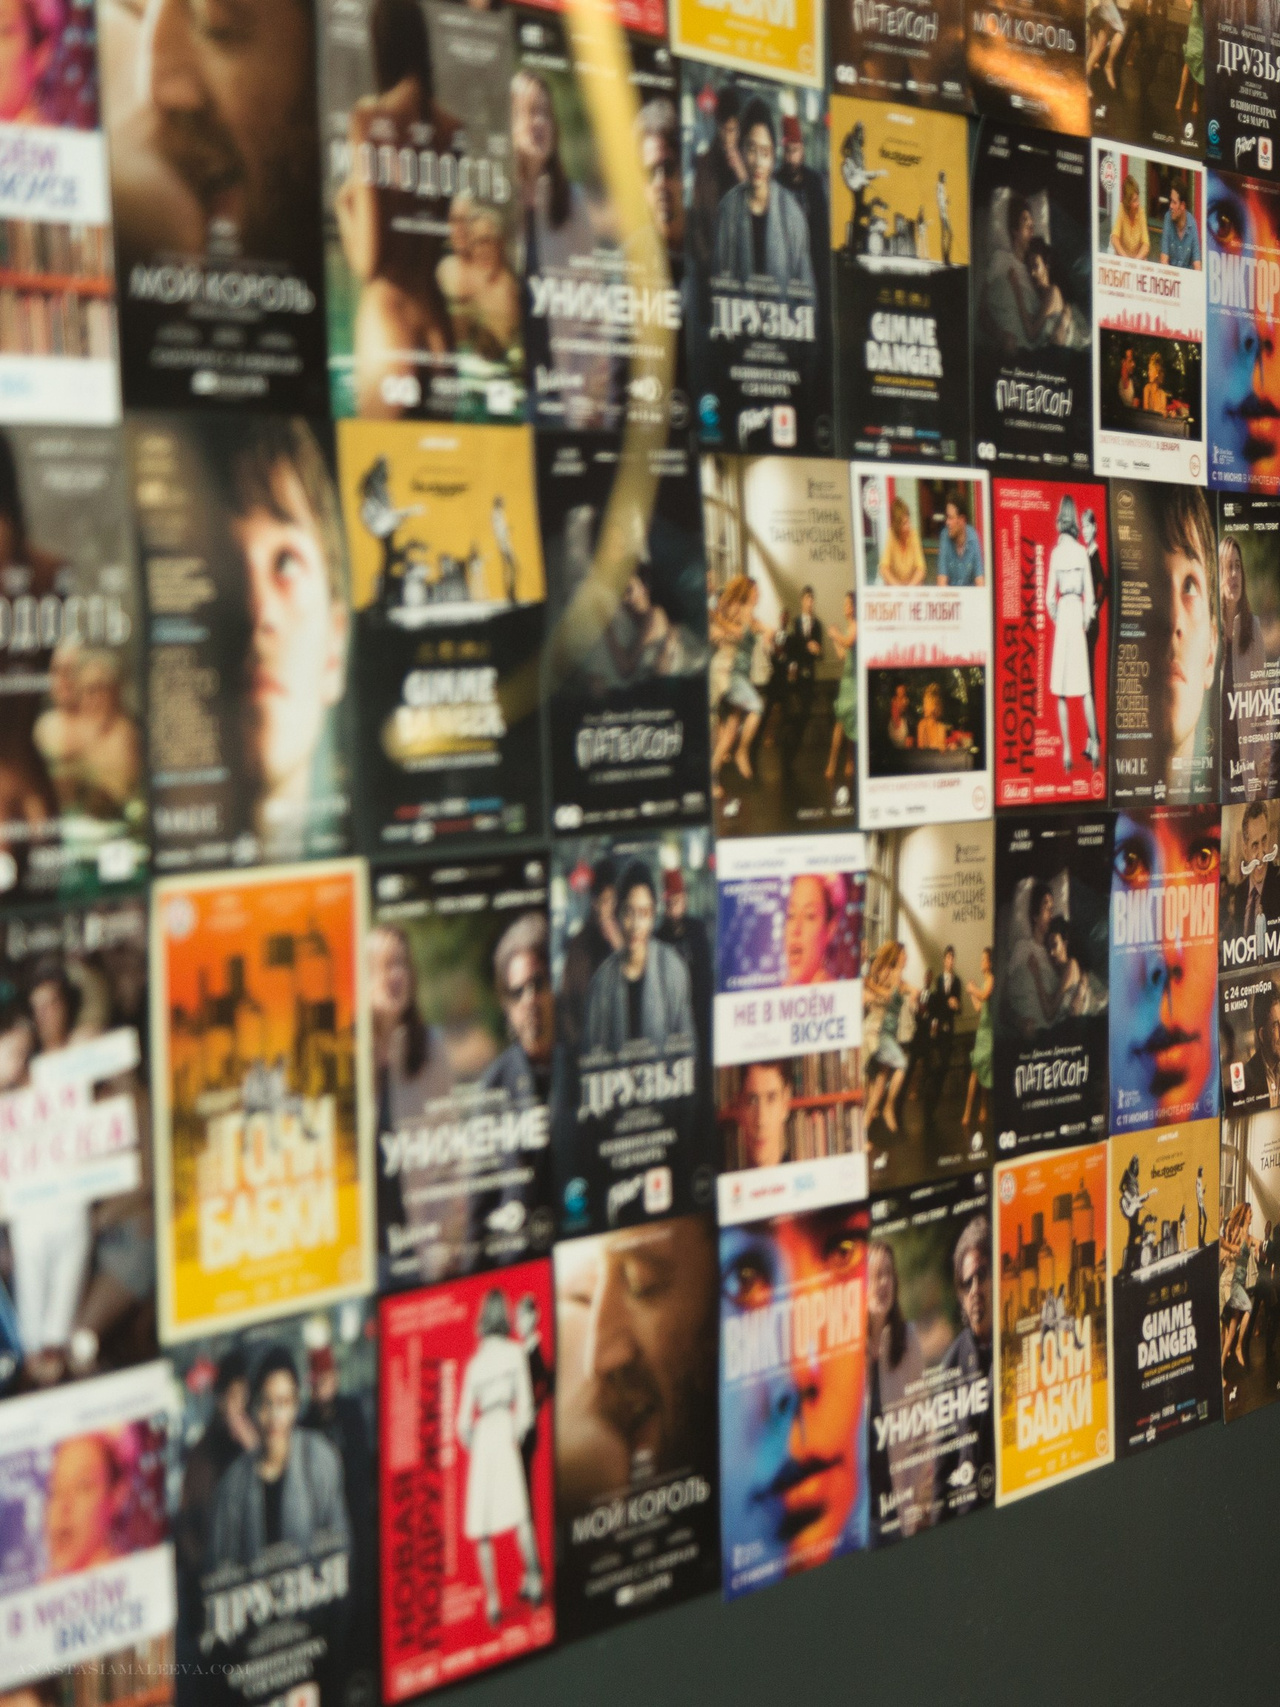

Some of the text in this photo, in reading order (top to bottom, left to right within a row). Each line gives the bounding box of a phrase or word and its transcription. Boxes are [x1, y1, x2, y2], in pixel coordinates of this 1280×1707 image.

[852, 0, 939, 42] ПАТЕРСОН
[973, 10, 1077, 53] МОЙ КОРОЛЬ
[1097, 266, 1182, 300] ЛЮБИТ ЛЮБИТ
[709, 296, 816, 342] ДРУЗЬЯ
[871, 311, 938, 346] GIMME
[865, 340, 943, 378] DANGER
[996, 379, 1073, 419] ПАТЕРСОН
[863, 601, 961, 622] ЛЮБИТ ЛЮБИТ
[1019, 536, 1037, 775] ПОДРУЖКА
[1117, 661, 1150, 679] ВСЕГО
[1118, 643, 1138, 661] ЭТО
[1002, 623, 1019, 766] НОВАЯ
[1116, 678, 1144, 695] ЛИШЬ
[1116, 695, 1149, 712] КОНЕЦ
[1115, 712, 1149, 729] СВЕТА
[1115, 758, 1148, 776] VOGUE
[917, 888, 987, 909] ТАНЦУЮЩИЕ
[952, 907, 986, 924] МЕЧТЫ
[1113, 883, 1216, 946] ВИКТОРИЯ
[1223, 936, 1257, 967] МОЯ
[734, 993, 836, 1026] НЕ МОЁМ
[1229, 980, 1272, 1000] 24 сентября
[789, 1018, 846, 1045] ВКУСЕ
[579, 1057, 695, 1120] ДРУЗЬЯ
[1014, 1055, 1090, 1098] ПАТЕРСОН
[381, 1107, 549, 1175] УНИЖЕНИЕ
[724, 1278, 866, 1384] ВИКТОРИЯ
[1142, 1301, 1193, 1342] GIMME
[1029, 1315, 1092, 1394] ГОНИ
[1138, 1329, 1198, 1370] DANGER
[873, 1378, 989, 1453] УНИЖЕНИЕ
[1017, 1375, 1093, 1452] БАБКИ
